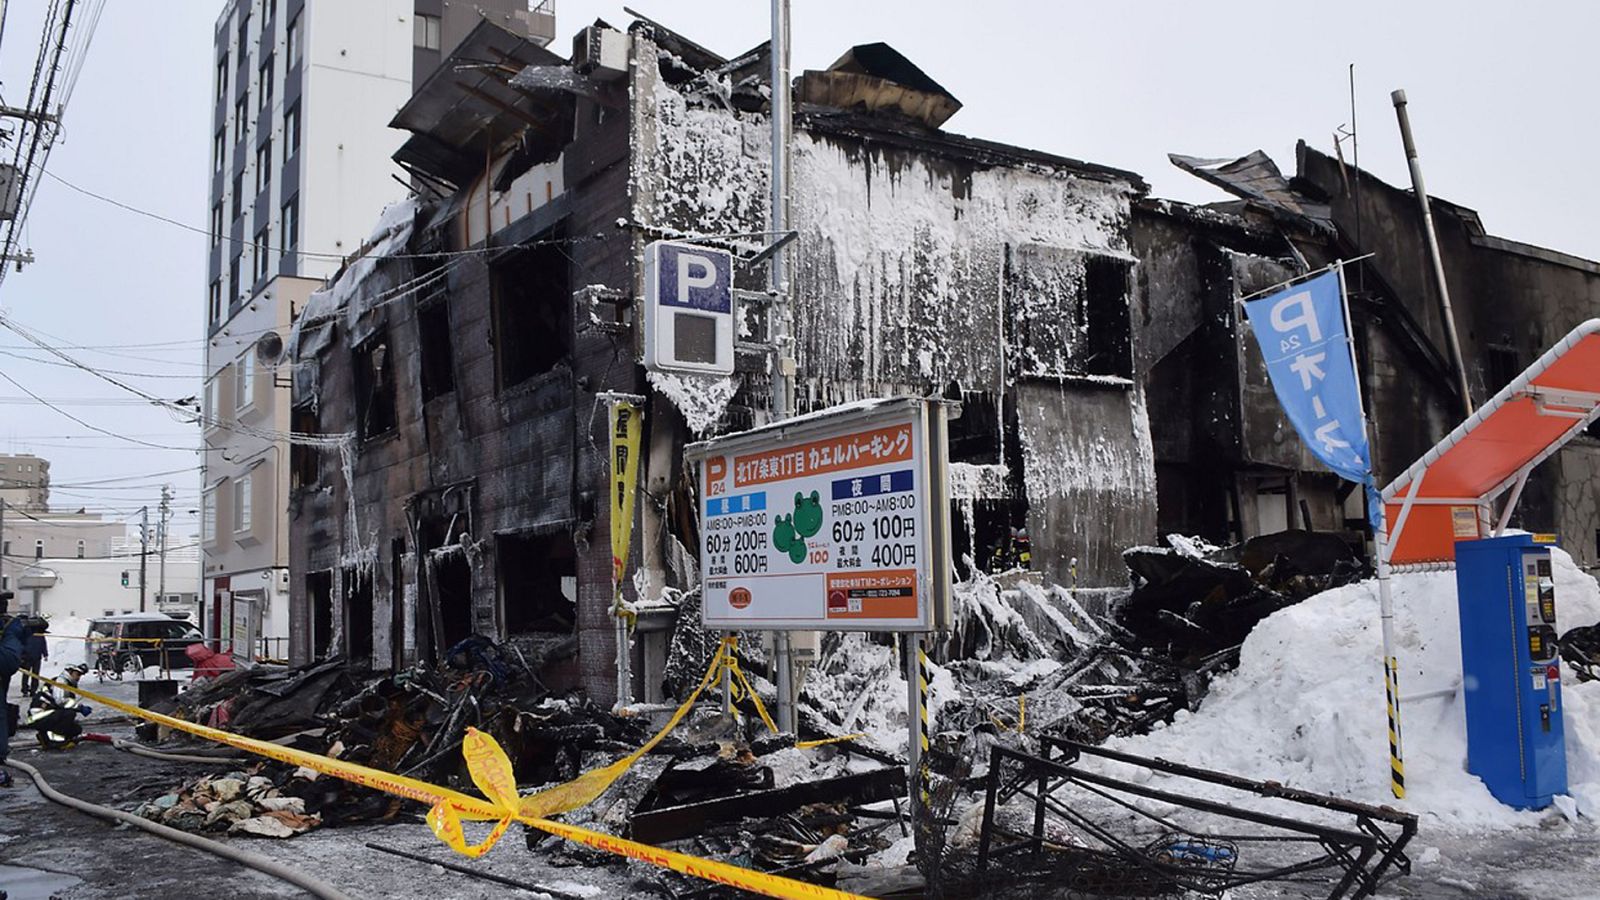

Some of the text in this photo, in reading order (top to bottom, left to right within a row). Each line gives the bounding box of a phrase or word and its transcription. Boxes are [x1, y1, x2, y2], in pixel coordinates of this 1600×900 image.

[677, 252, 717, 303] P
[736, 429, 910, 483] 北17条東1丁目 カエルパーキング
[706, 455, 727, 497] P 24
[832, 515, 916, 543] 60分 100円
[706, 530, 767, 555] 60分 200円
[871, 543, 917, 568] 400円
[734, 553, 768, 574] 600円
[809, 550, 829, 565] 100
